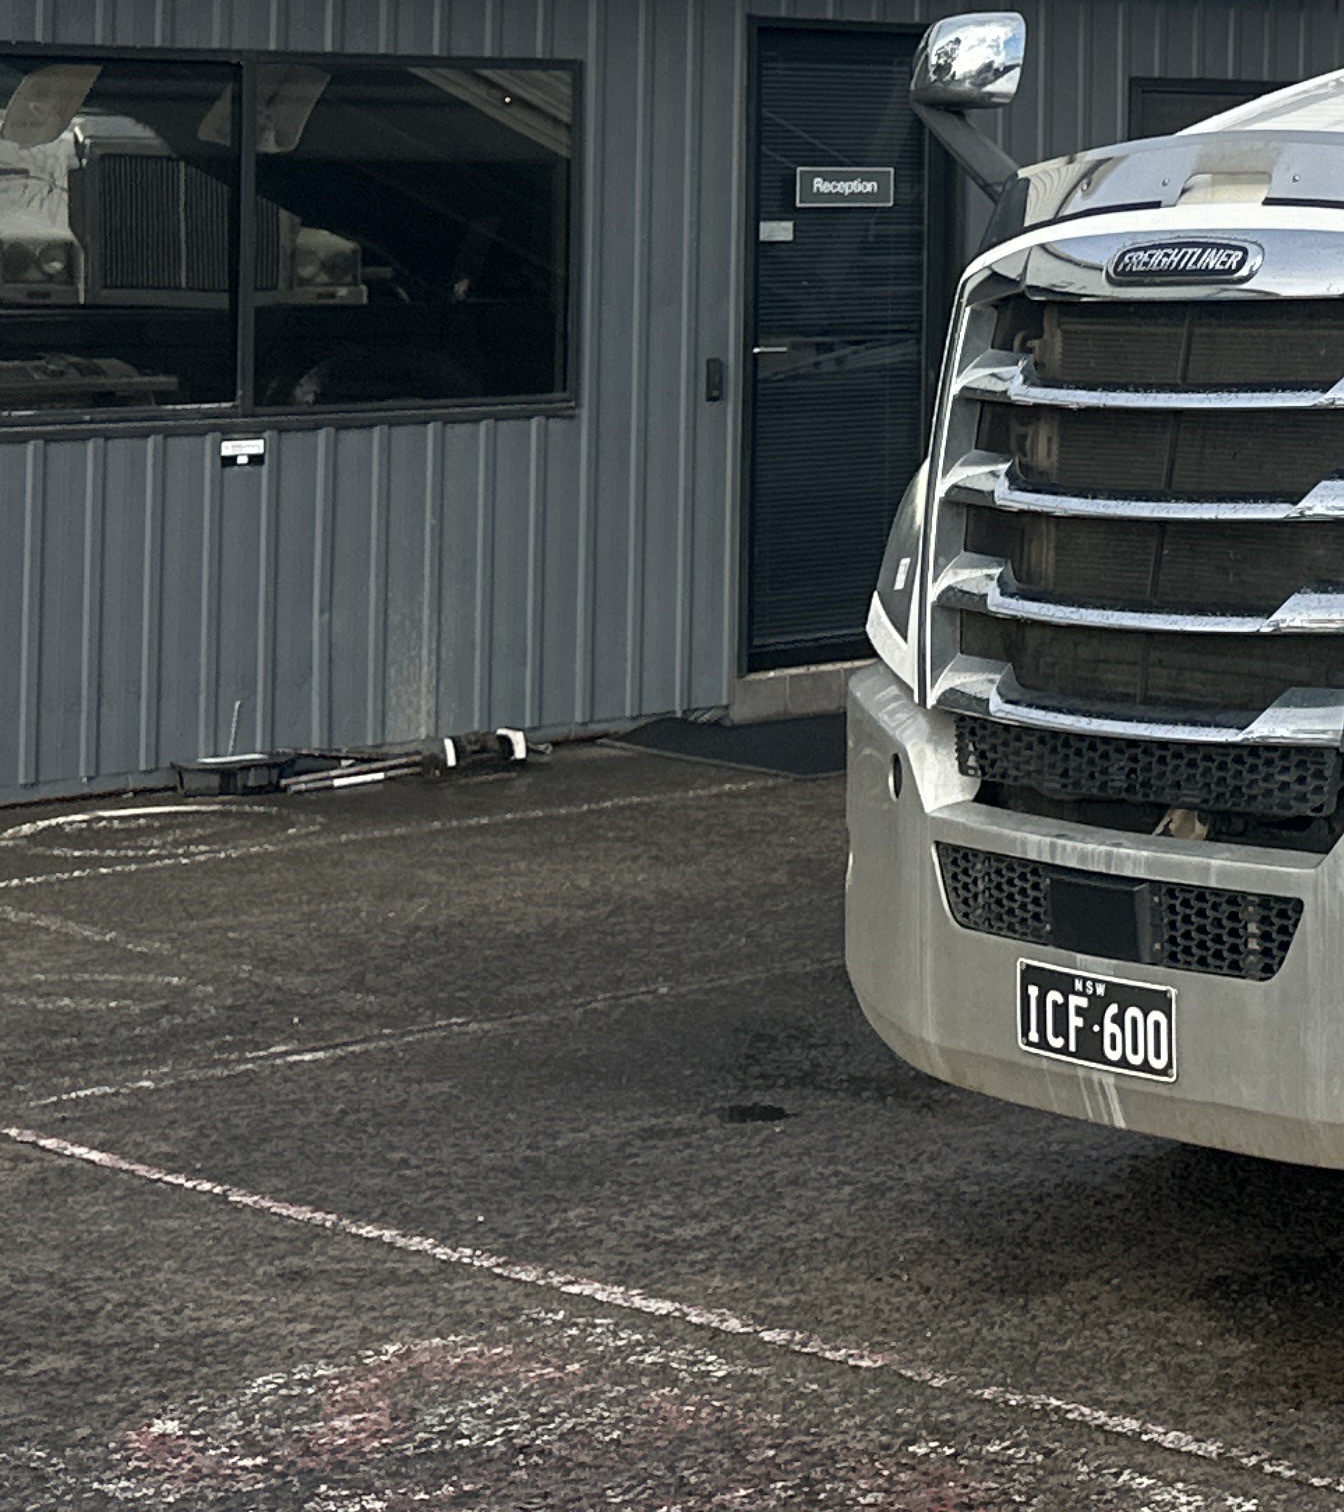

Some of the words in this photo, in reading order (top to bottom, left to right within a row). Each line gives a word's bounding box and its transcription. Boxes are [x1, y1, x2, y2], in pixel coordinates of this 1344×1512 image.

[812, 174, 879, 196] Reception
[1118, 247, 1243, 273] FREIGHTLINER
[1074, 978, 1107, 997] NSW
